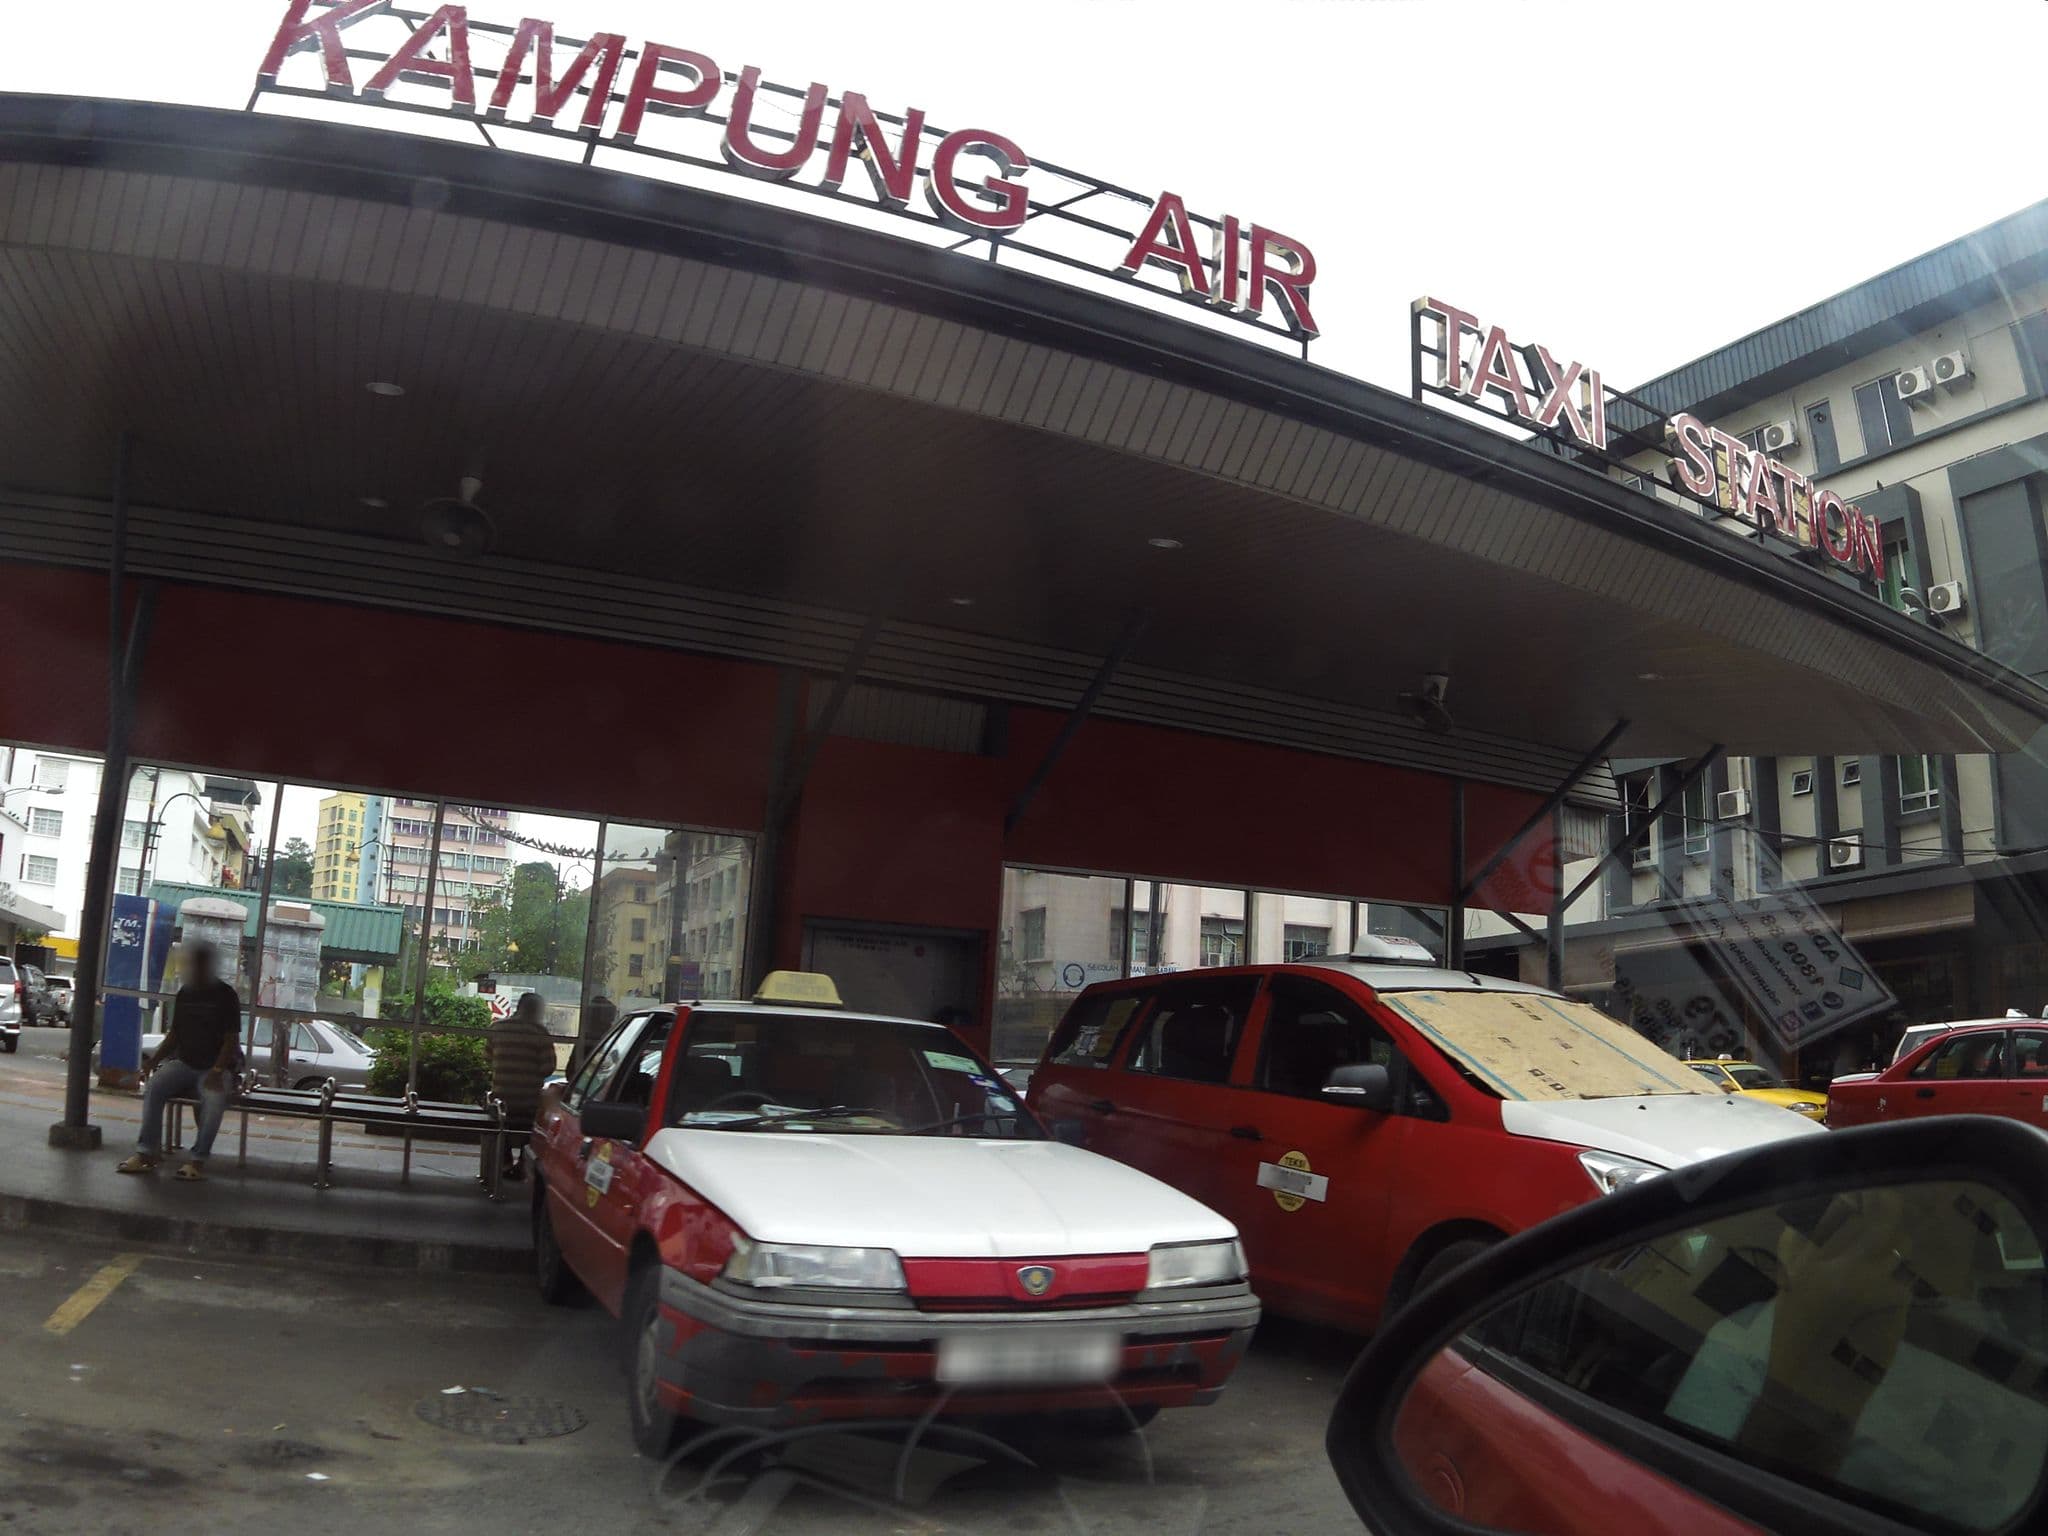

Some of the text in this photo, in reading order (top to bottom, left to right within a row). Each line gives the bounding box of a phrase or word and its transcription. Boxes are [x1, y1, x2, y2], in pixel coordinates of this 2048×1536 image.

[256, 0, 1886, 583] KAMPUNG AIR TAXI STATION
